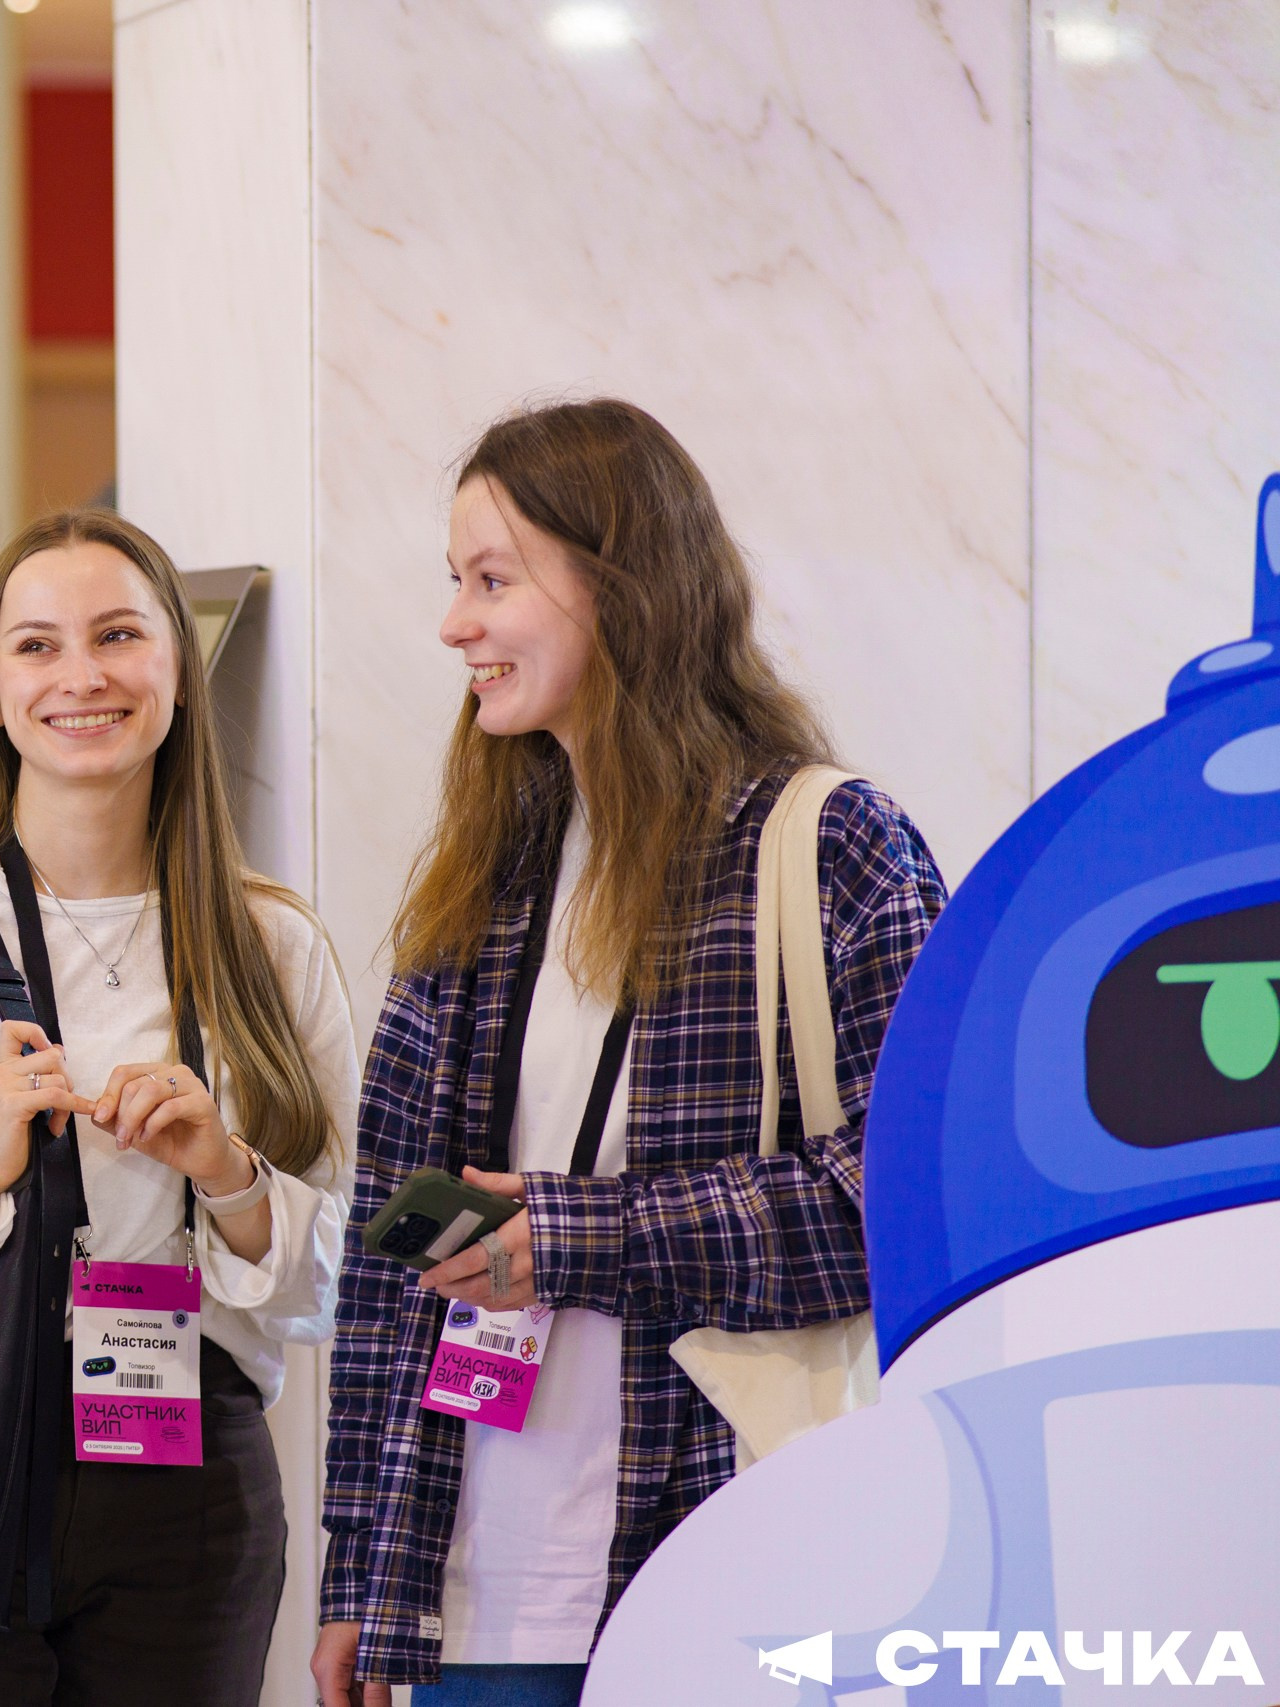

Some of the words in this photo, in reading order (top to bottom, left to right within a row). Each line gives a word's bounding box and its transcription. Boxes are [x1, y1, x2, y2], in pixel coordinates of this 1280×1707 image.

[95, 1283, 144, 1294] СТАЧКА
[117, 1318, 163, 1330] Самойлова
[101, 1332, 177, 1351] Анастасия
[127, 1361, 156, 1371] Топвизор
[442, 1350, 528, 1386] УЧАСТНИК
[434, 1368, 470, 1388] ВИП
[80, 1402, 187, 1422] УЧАСТНИК
[81, 1419, 122, 1435] ВИП
